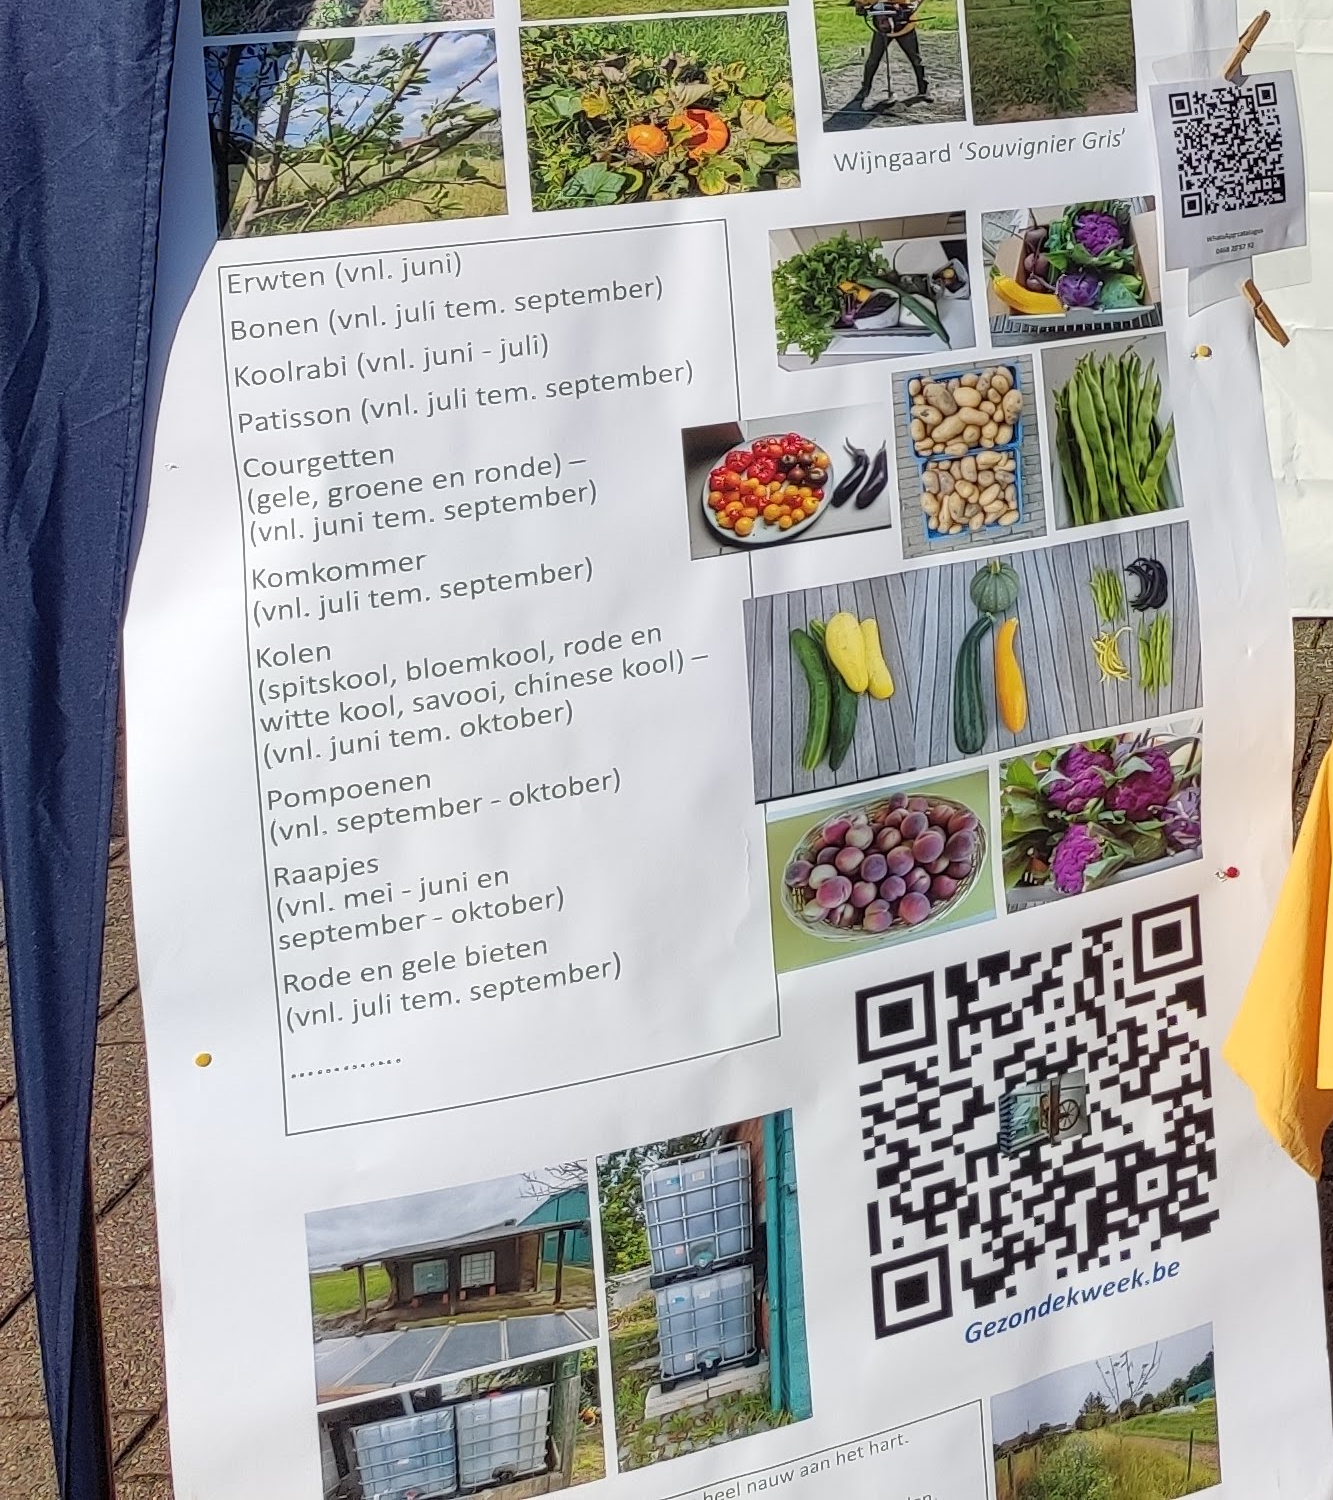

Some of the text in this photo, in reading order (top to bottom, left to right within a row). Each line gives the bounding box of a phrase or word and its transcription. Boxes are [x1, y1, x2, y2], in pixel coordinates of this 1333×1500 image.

[832, 142, 951, 175] Wijngaard
[227, 250, 461, 295] Erwten (vnl. juni)
[230, 275, 663, 342] Bonen (vnl. juli tem. september)
[234, 355, 347, 388] Koolrabi
[357, 347, 415, 380] (vnl.
[422, 341, 473, 373] juni
[498, 332, 549, 365] juli)
[237, 359, 693, 434] Patisson (vnl. juli tem. september)
[242, 448, 395, 485] Courgetten
[247, 484, 319, 516] (gele,
[327, 476, 424, 509] groene
[432, 471, 465, 490] en
[474, 452, 562, 485] ronde)
[250, 478, 597, 548] (vnl. juni tem. september)
[252, 554, 428, 591] Komkommer
[253, 556, 593, 629] (vnl. juli tem. september)
[256, 642, 331, 669] Kolen
[258, 627, 662, 706] (spitskool, bloemkool, rode en
[259, 708, 330, 733] witte
[339, 693, 404, 724] kool,
[412, 680, 506, 713] savooi,
[514, 667, 614, 697] chinese
[622, 648, 684, 680] kool)
[263, 699, 573, 770] (vnl. juni tem. oktober)
[267, 773, 431, 811] Pompoenen
[269, 814, 328, 848] (vnl.
[336, 796, 483, 835] september
[508, 767, 621, 807] oktober)
[273, 857, 380, 889] Raapjes
[276, 891, 336, 924] (vnl.
[343, 881, 393, 910] mei
[418, 871, 468, 903] juni
[477, 870, 509, 889] en
[278, 913, 428, 952] september
[451, 885, 564, 924] oktober)
[283, 939, 548, 995] Rode en gele bieten
[286, 951, 622, 1035] (vnl. juli tem. september)
[963, 1259, 1181, 1346] Gezondekweek.be
[746, 1467, 795, 1494] nauw
[799, 1457, 831, 1478] aan
[835, 1446, 865, 1466] het
[868, 1432, 909, 1457] hart.
